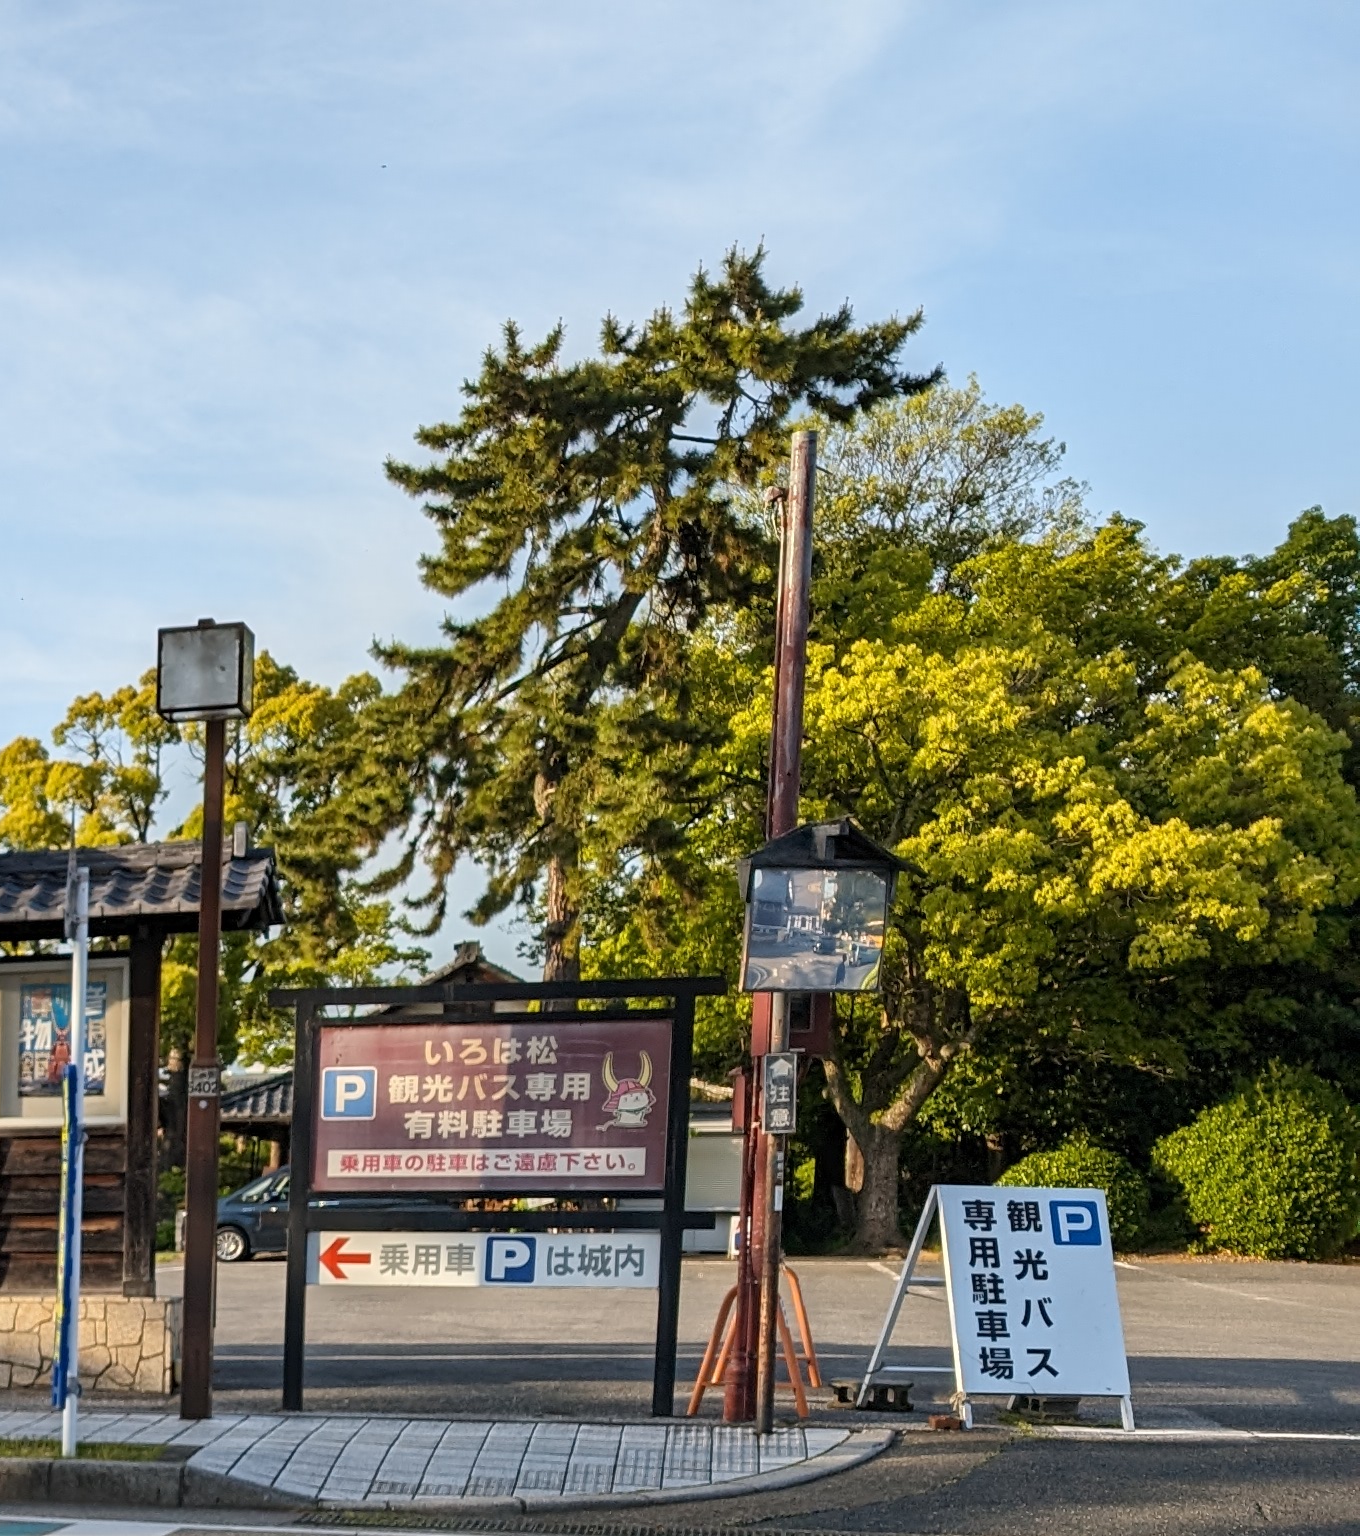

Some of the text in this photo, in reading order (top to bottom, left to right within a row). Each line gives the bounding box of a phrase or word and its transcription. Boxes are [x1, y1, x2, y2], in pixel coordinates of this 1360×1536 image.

[424, 1036, 559, 1066] いろは松
[335, 1075, 367, 1113] P
[388, 1072, 591, 1104] 観光バス専用
[769, 1085, 790, 1127] 注意
[404, 1109, 573, 1140] 有料駐車場
[340, 1153, 637, 1173] 乗用車の駐車はご遠慮下さい。
[1056, 1205, 1094, 1243] P
[379, 1240, 645, 1280] 乗用車 P は城内
[961, 1199, 1015, 1381] 専用駐車場
[1006, 1200, 1060, 1378] 観光バス
